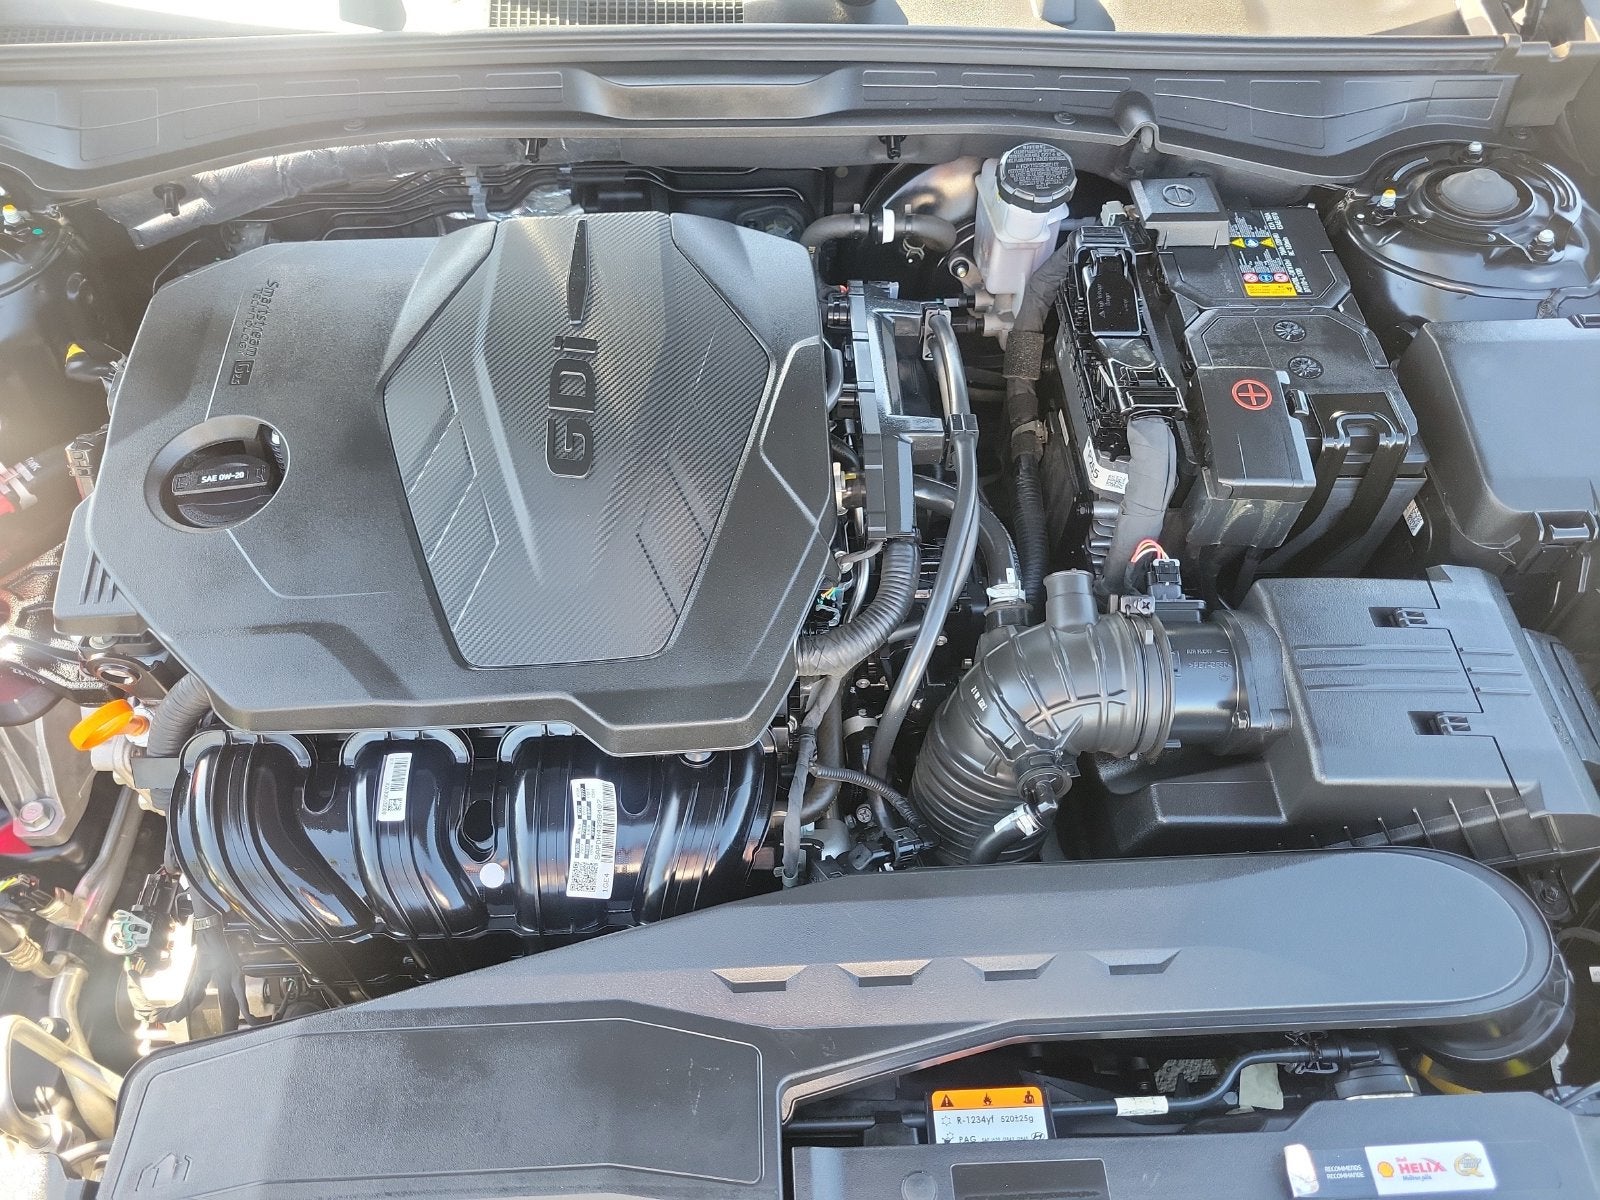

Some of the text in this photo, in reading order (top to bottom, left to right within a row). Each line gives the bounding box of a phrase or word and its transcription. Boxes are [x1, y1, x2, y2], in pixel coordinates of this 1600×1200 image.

[245, 279, 280, 357] Smartstream
[201, 471, 245, 484] SAE 0W-20
[956, 1115, 1034, 1125] R-1234yf 520±25g
[1397, 1161, 1446, 1174] HELIX
